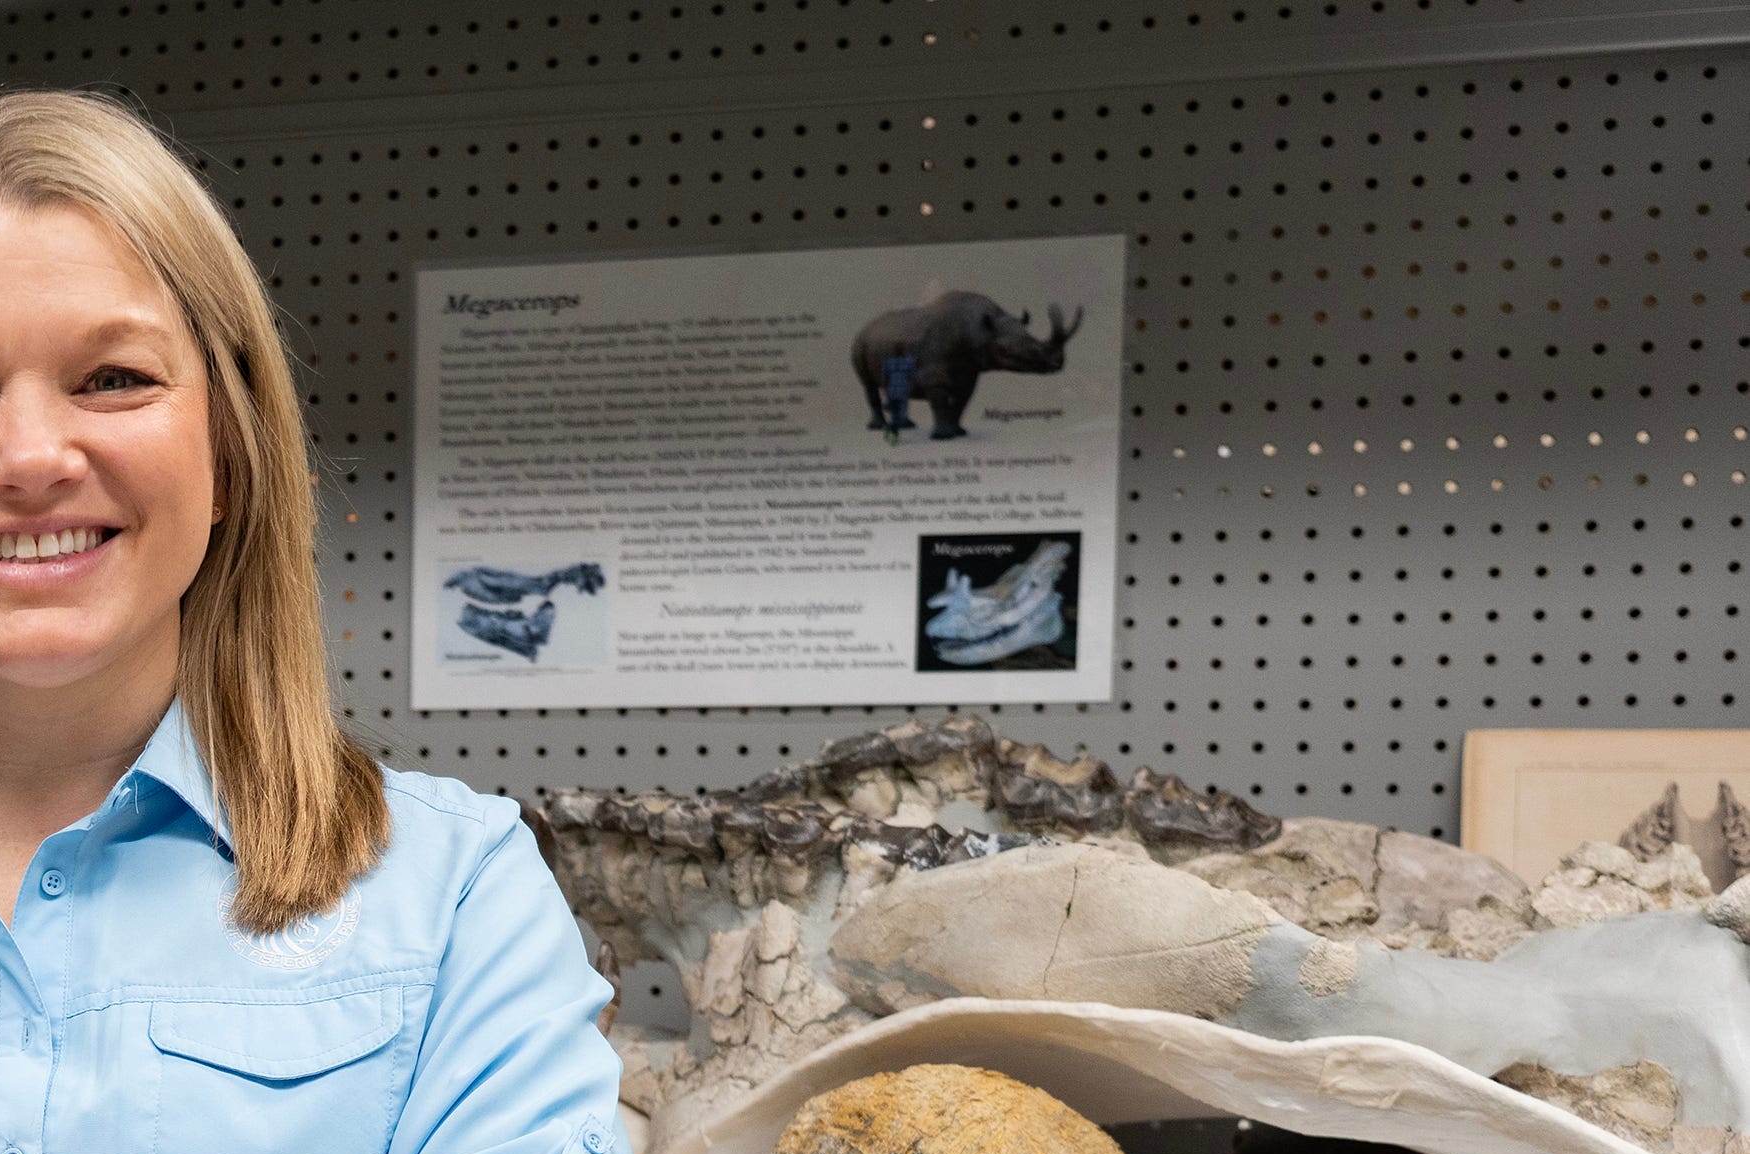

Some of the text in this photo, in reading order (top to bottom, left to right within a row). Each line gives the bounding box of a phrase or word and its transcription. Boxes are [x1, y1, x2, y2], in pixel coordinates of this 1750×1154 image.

[443, 293, 581, 320] Megacerops
[983, 405, 1065, 423] Megacerops
[343, 899, 359, 941] PARKS
